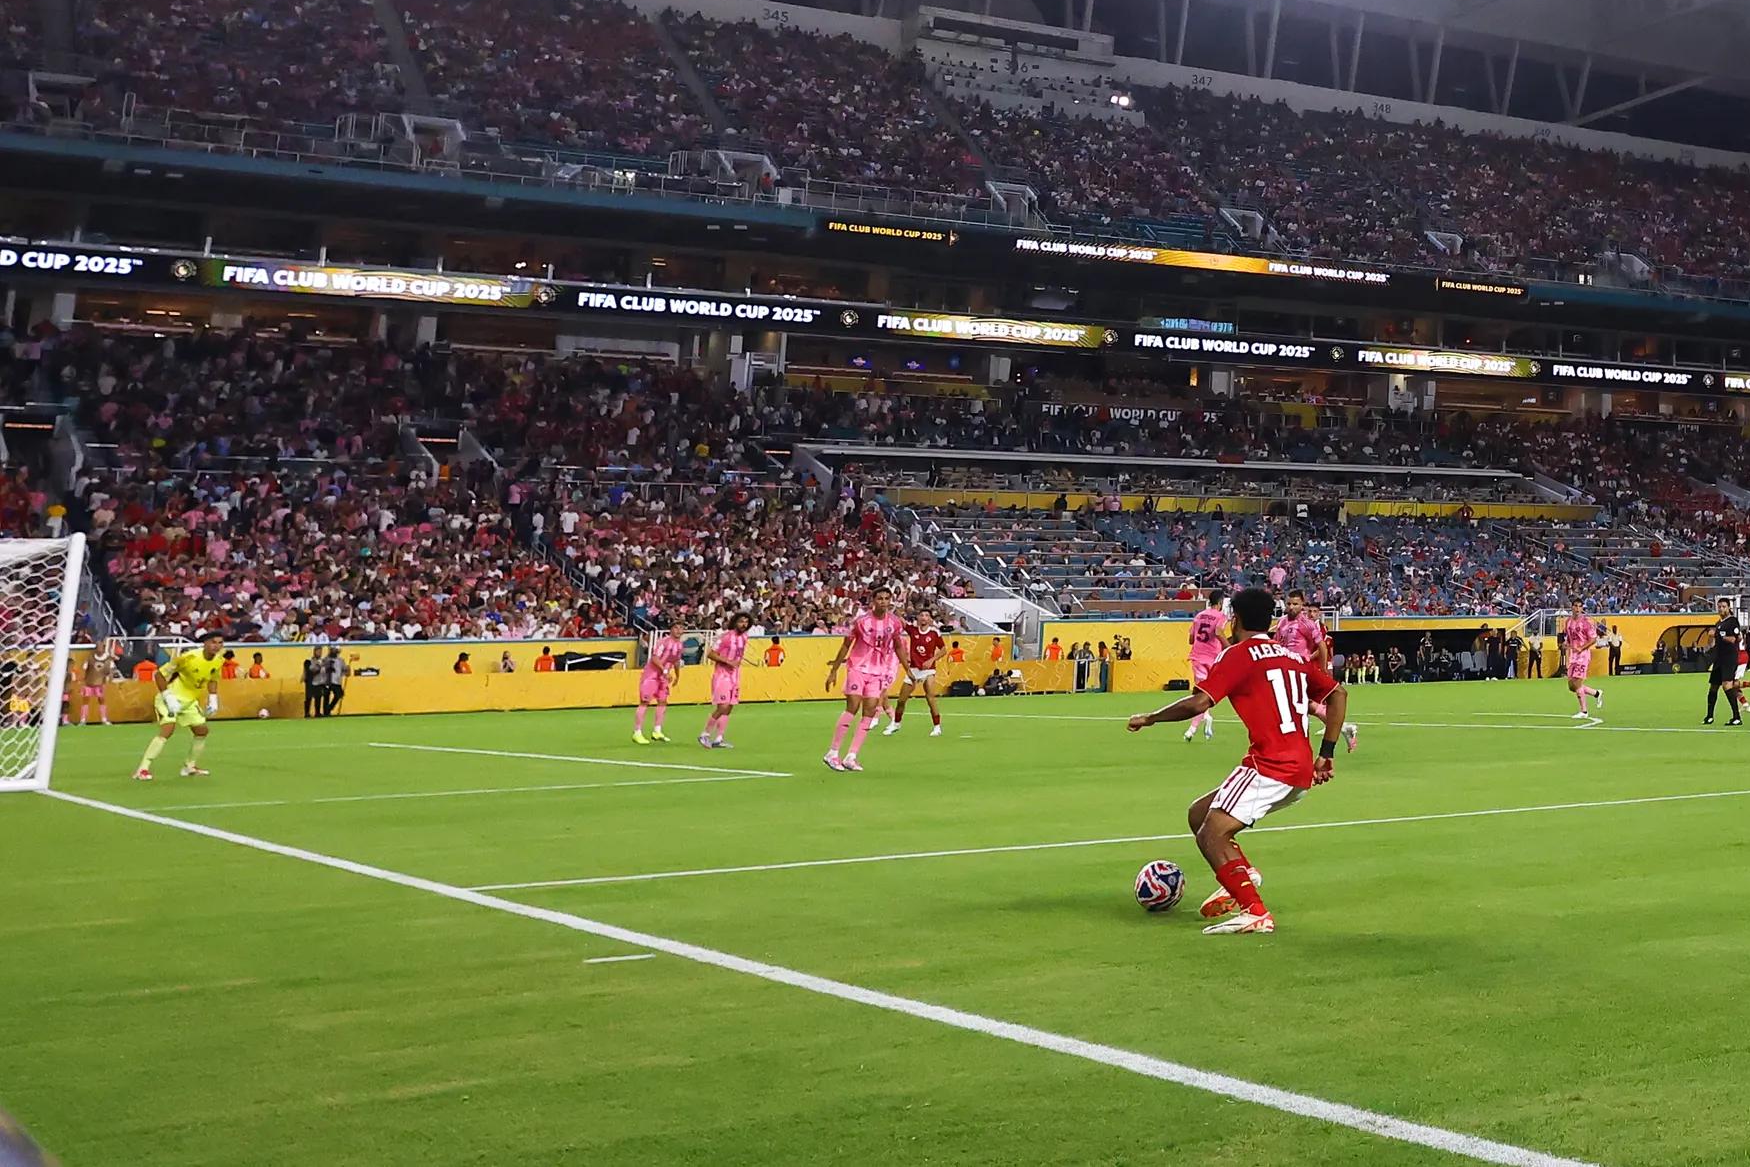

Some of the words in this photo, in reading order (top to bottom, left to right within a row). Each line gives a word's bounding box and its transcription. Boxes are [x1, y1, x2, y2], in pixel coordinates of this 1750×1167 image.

[763, 8, 789, 23] 345
[1004, 59, 1028, 72] 36
[1191, 74, 1212, 86] 347
[829, 222, 847, 232] FIFA
[849, 223, 871, 234] CLUB
[872, 226, 903, 237] WORLD
[904, 229, 921, 239] CUP
[1017, 239, 1039, 251] FIFA
[1040, 241, 1067, 253] CLUB
[1068, 243, 1106, 256] WORLD
[1107, 247, 1127, 258] CUP
[22, 251, 70, 270] CUP
[1268, 262, 1288, 273] FIFA
[1290, 264, 1313, 276] CLUB
[1314, 266, 1346, 278] WORLD
[1347, 269, 1364, 280] CUP
[223, 265, 269, 284] FIFA
[273, 269, 327, 288] CLUB
[332, 273, 406, 294] WORLD
[410, 279, 450, 297] CUP
[1441, 281, 1455, 289] FIFA
[1455, 282, 1471, 291] CLUB
[1472, 283, 1493, 292] WORLD
[1494, 285, 1506, 294] CUP
[578, 292, 617, 310] FIFA
[620, 294, 666, 312] CLUB
[669, 298, 732, 317] WORLD
[735, 304, 769, 320] CUP
[877, 315, 911, 331] FIFA
[913, 318, 953, 333] CLUB
[955, 321, 1007, 336] WORLD
[1011, 325, 1041, 340] CUP
[1134, 334, 1164, 348] FIFA
[1166, 336, 1200, 350] CLUB
[1202, 339, 1250, 354] WORLD
[1251, 343, 1277, 356] CUP
[1358, 350, 1384, 364] FIFA
[1385, 352, 1416, 365] CLUB
[1417, 354, 1458, 368] WORLD
[1460, 358, 1483, 370] CUP
[1552, 364, 1576, 377] FIFA
[1576, 366, 1603, 379] CLUB
[1604, 368, 1641, 382] WORLD
[1642, 371, 1662, 383] CUP
[1725, 377, 1745, 389] FIFA
[1196, 623, 1211, 643] 5
[1266, 668, 1308, 738] 14
